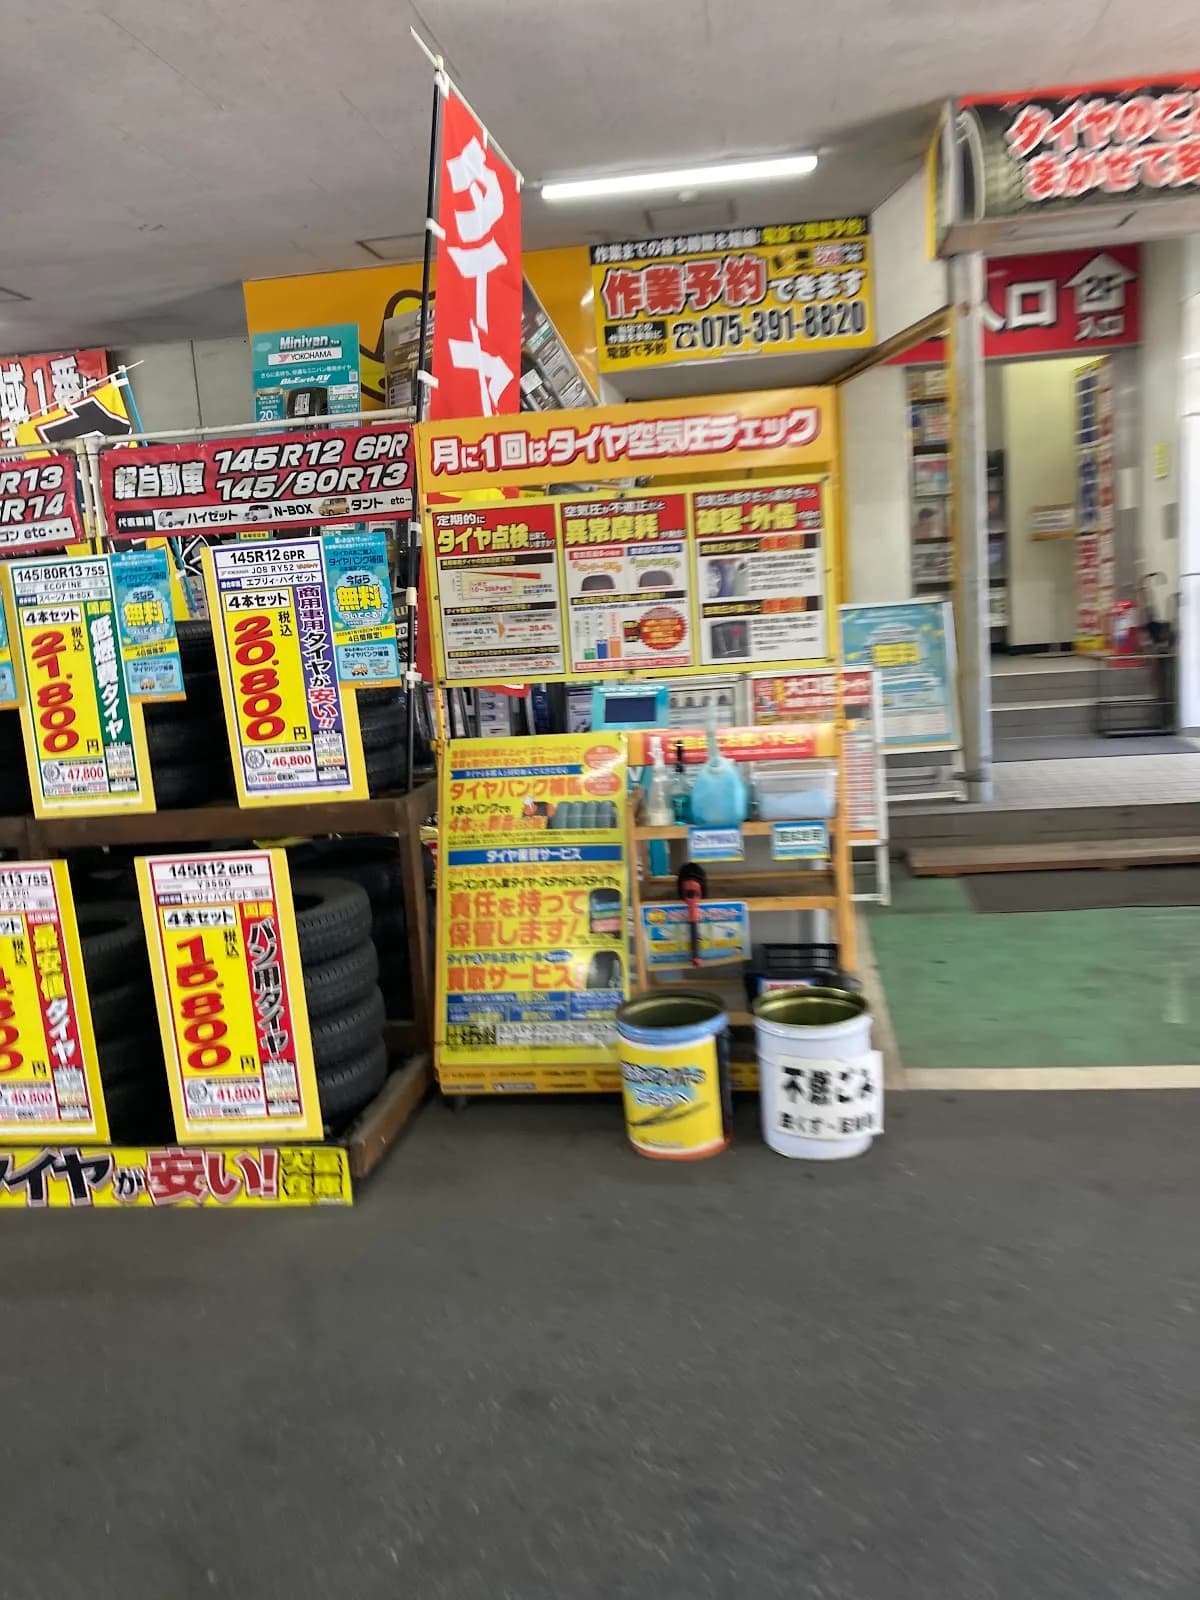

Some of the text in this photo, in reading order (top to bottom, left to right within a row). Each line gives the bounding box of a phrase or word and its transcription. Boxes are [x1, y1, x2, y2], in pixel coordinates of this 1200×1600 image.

[702, 300, 866, 348] 075-391-8820
[280, 335, 329, 350] Minivan
[291, 349, 332, 361] YOKOHAMA
[431, 406, 820, 475] 月に1回はタイヤ空気圧チェック
[214, 430, 409, 476] 145R12 6PR
[113, 461, 206, 500] 軽自動車
[214, 467, 409, 502] 145/80R13
[274, 504, 313, 521] N-BOX
[437, 523, 530, 553] タイヤ点検
[230, 549, 306, 566] 145R12 6PR
[18, 565, 106, 581] 145/80R13 75S
[271, 564, 295, 574] RY52
[228, 593, 288, 610] 4本セット
[26, 610, 80, 624] 4本セット
[293, 727, 308, 741] 円
[86, 739, 100, 754] 円
[168, 861, 254, 879] 145R12 6PR
[450, 888, 587, 920] 責任を持って
[167, 910, 234, 927] 4本セット
[0, 1147, 279, 1206] イヤが安い!
